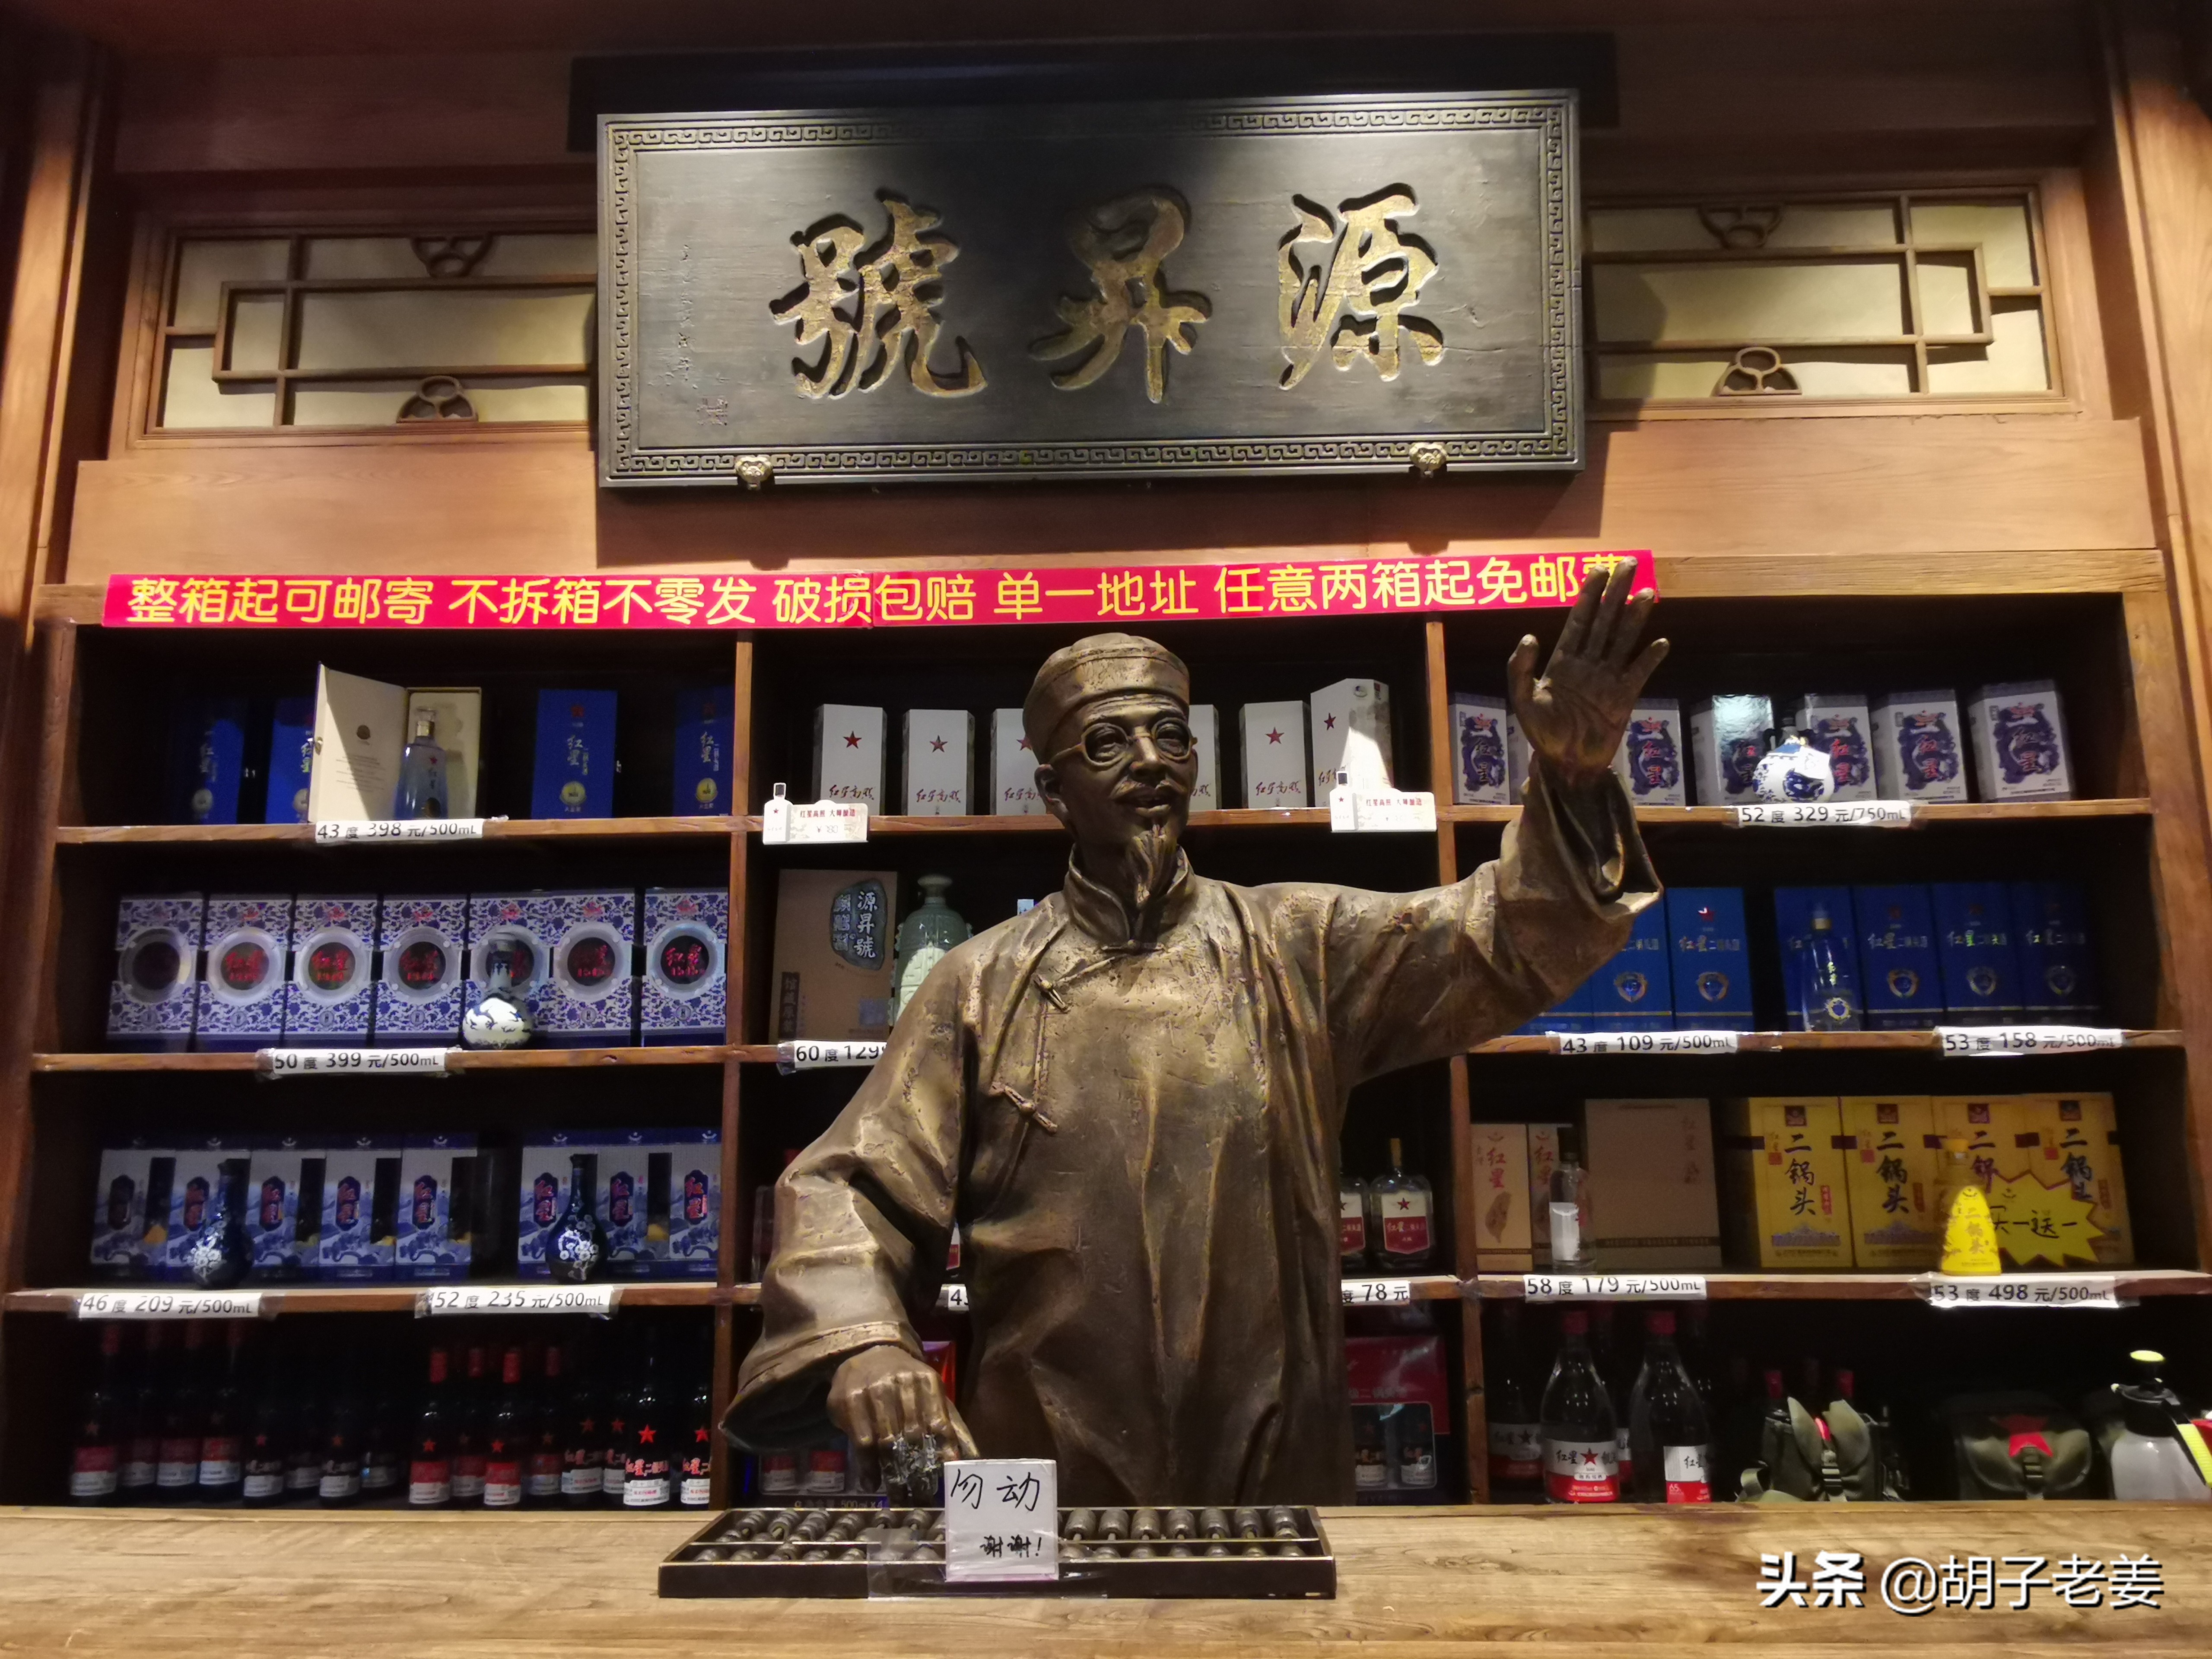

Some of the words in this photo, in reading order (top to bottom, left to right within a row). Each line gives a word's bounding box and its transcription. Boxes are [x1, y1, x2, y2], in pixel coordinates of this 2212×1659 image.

[127, 577, 433, 625] 整箱起可邮寄
[449, 577, 757, 625] 不拆箱不零发
[773, 573, 976, 624] 破损包赔
[994, 570, 1198, 620] 单一地址
[1004, 787, 1040, 801] 红星高
[1742, 807, 1764, 822] 52
[1771, 810, 1785, 823] 度
[1794, 806, 1828, 821] 329
[317, 824, 340, 839] 43
[346, 827, 359, 839] 度
[367, 823, 401, 837] 398
[854, 891, 878, 958] 源昇號
[1562, 1038, 1587, 1054] 43
[1616, 1035, 1653, 1051] 109
[1944, 1034, 1970, 1051] 53
[2000, 1032, 2037, 1049] 158
[274, 1053, 298, 1069] 50
[303, 1056, 318, 1070] 度
[326, 1052, 361, 1067] 399
[797, 1046, 819, 1062] 60
[825, 1049, 839, 1062] 度
[844, 1045, 886, 1060] 129
[1487, 1147, 1506, 1188] 红星
[1784, 1133, 1816, 1216] 二锅头
[1876, 1131, 1909, 1214] 二锅头
[1362, 1283, 1386, 1301] 78
[1394, 1286, 1408, 1301] 元
[1527, 1278, 1552, 1295] 58
[1559, 1281, 1574, 1295] 度
[1933, 1285, 1959, 1301] 53
[1988, 1284, 2028, 1300] 498
[83, 1295, 108, 1311] 46
[111, 1299, 128, 1313] 度
[434, 1291, 458, 1308] 52
[465, 1295, 480, 1309] 度
[487, 1291, 525, 1307] 235
[1556, 1449, 1578, 1465] 红星
[950, 1468, 1040, 1512] 勿动
